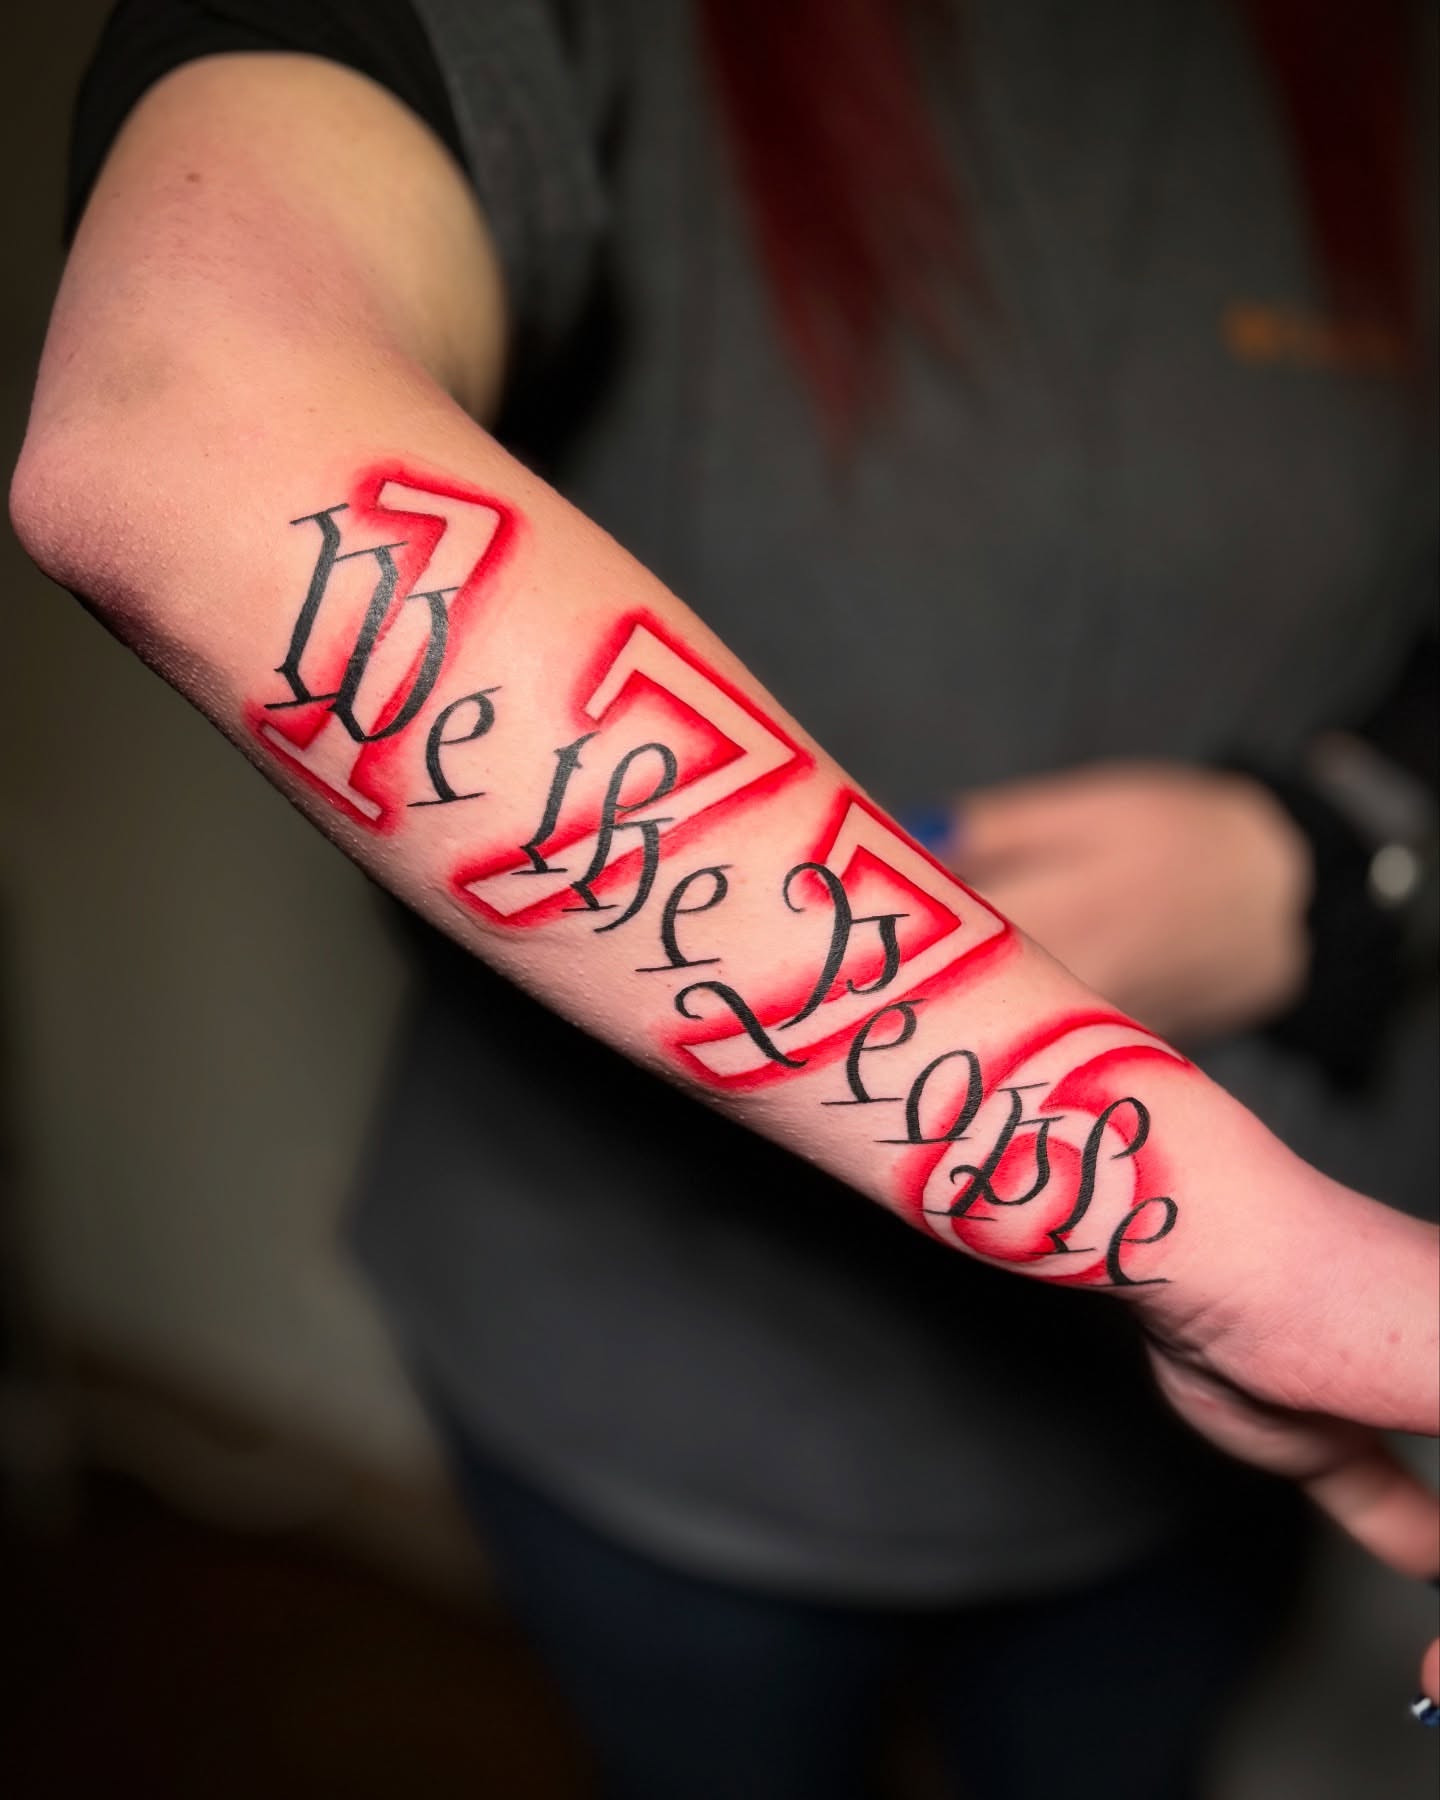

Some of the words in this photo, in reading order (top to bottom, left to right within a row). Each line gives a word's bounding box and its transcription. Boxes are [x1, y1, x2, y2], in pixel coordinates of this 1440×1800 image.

[256, 477, 1190, 1283] 1776
[264, 502, 503, 808] We
[674, 861, 1179, 1288] People
